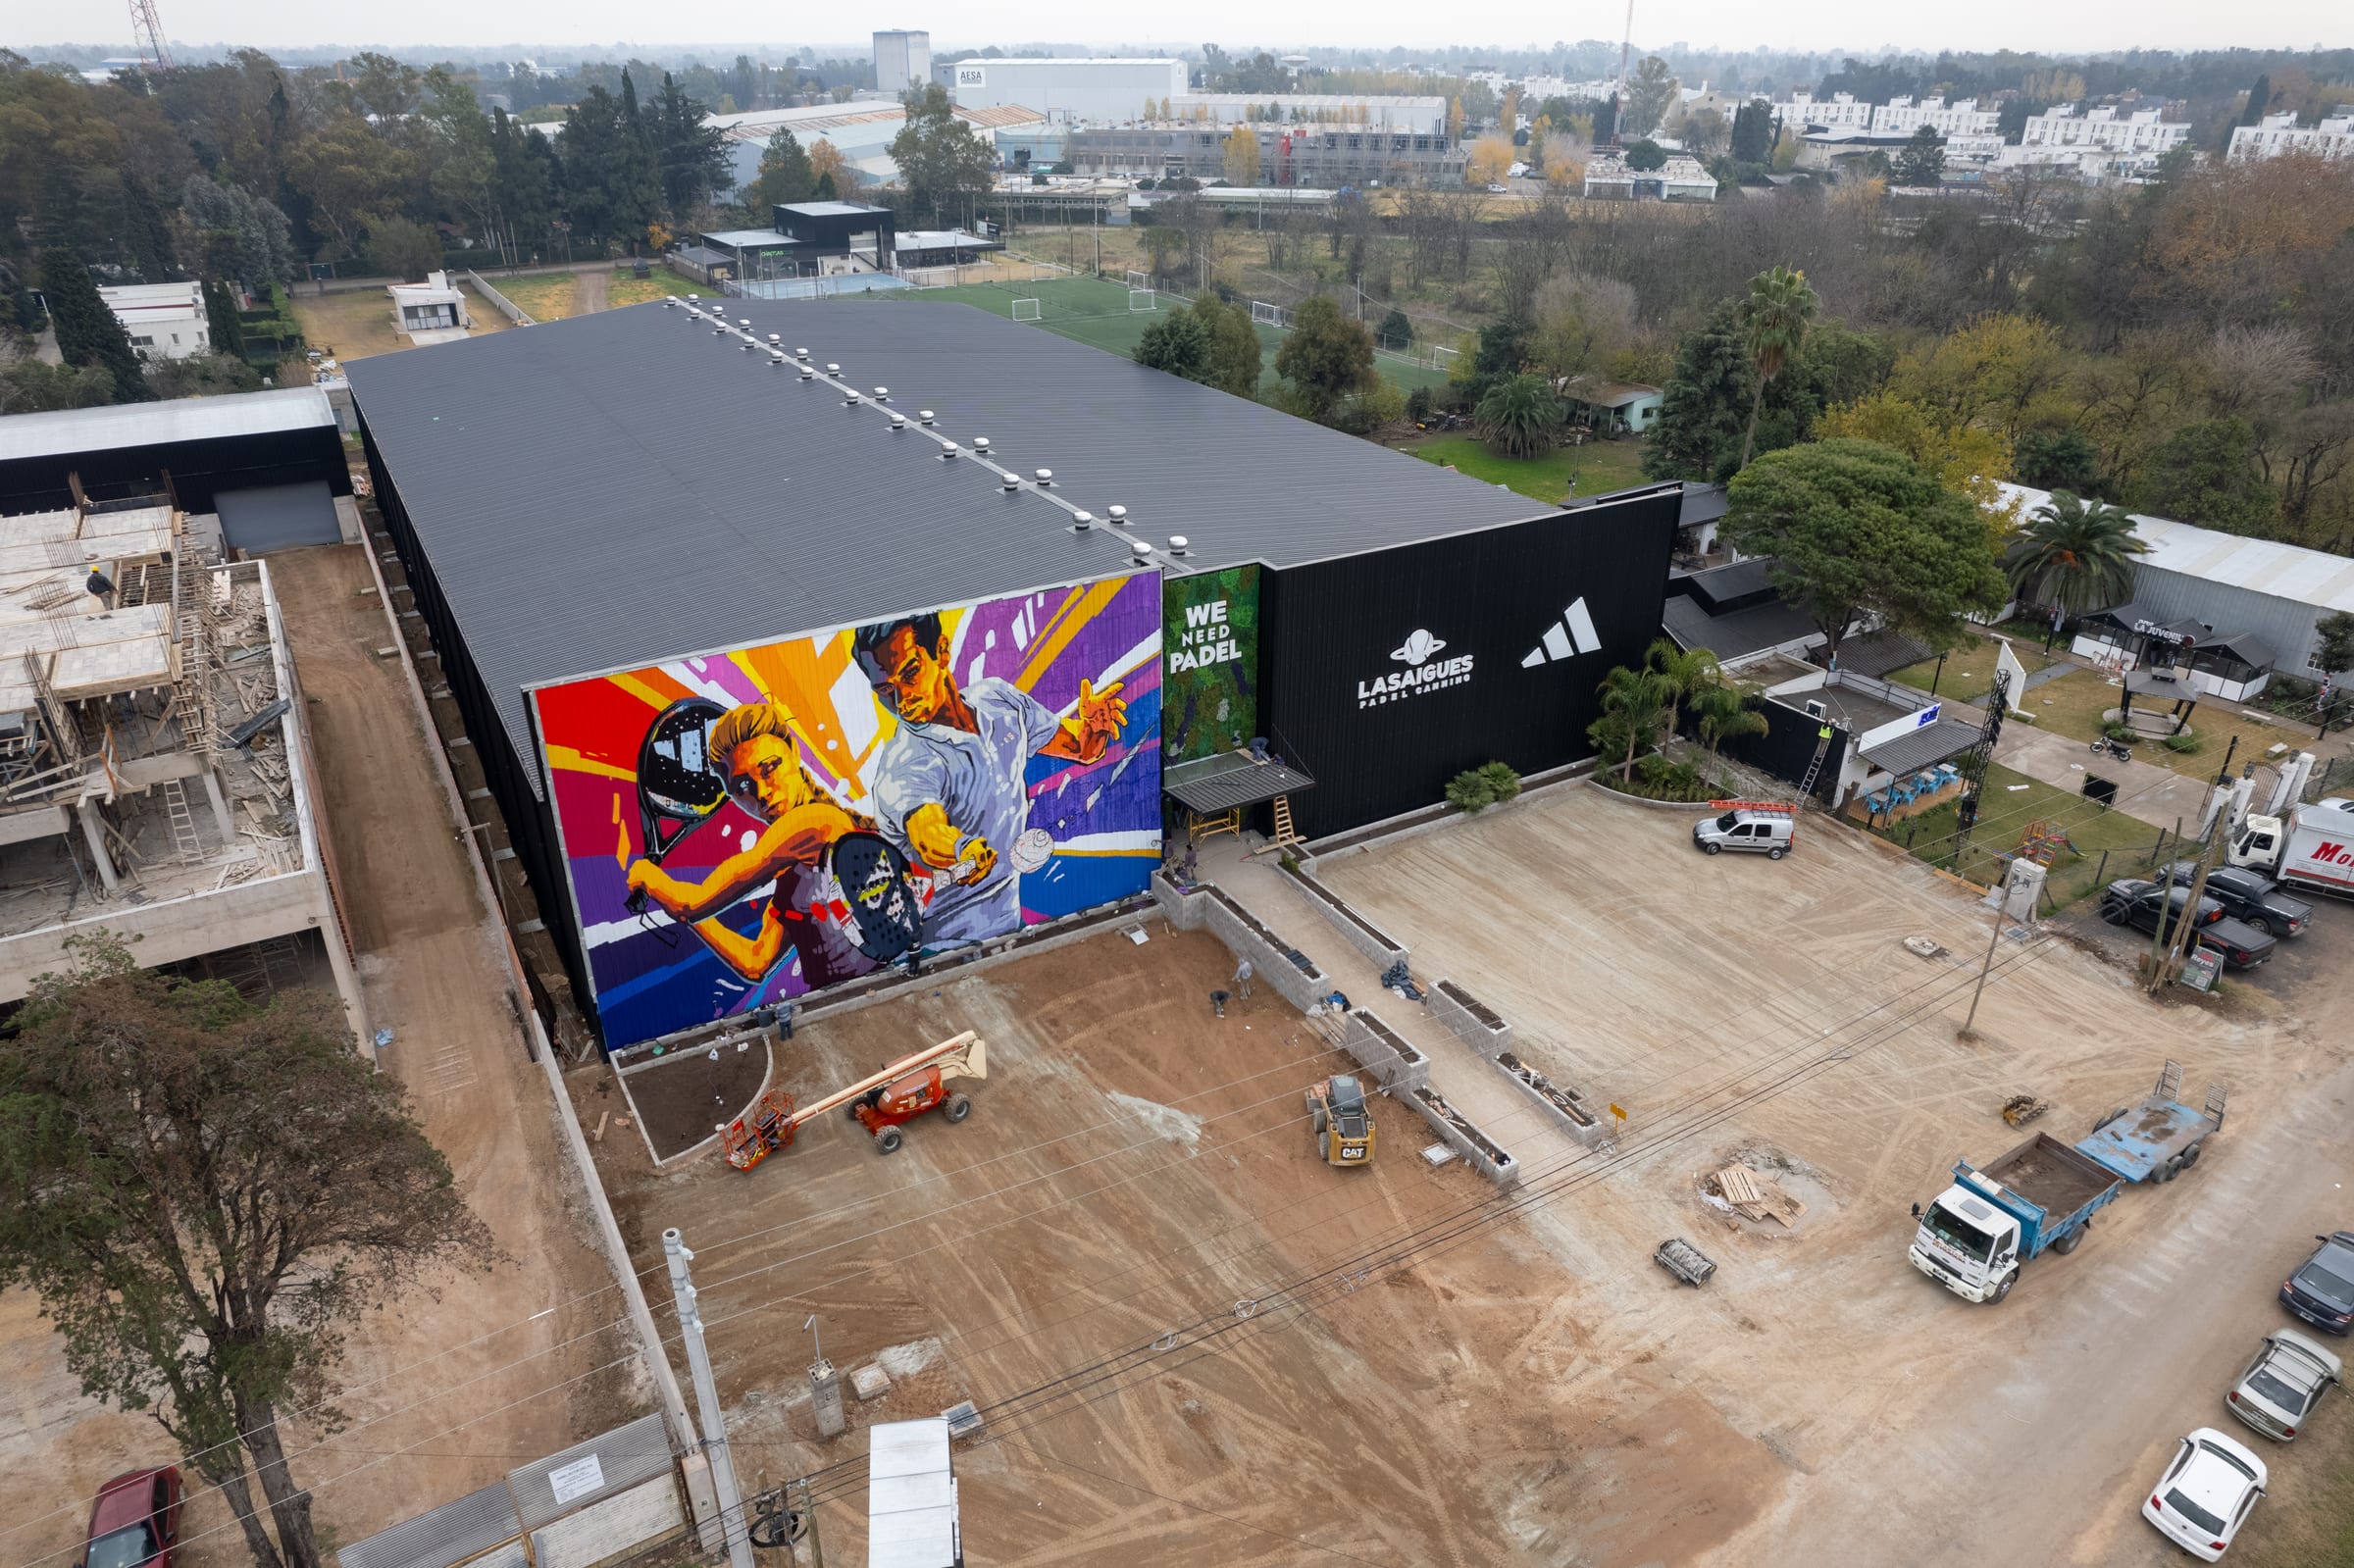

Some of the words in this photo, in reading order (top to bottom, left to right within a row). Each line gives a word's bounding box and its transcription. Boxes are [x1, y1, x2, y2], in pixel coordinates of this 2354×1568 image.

[960, 71, 982, 79] AESA
[1185, 600, 1227, 629] WE
[1182, 625, 1230, 647] NEED
[1170, 638, 1242, 675] PADEL
[1357, 654, 1474, 699] LASAIGUES
[1359, 690, 1408, 709] PADEL
[1415, 674, 1471, 695] CANNING
[2310, 841, 2354, 868] Mo
[1342, 1148, 1364, 1158] CAT
